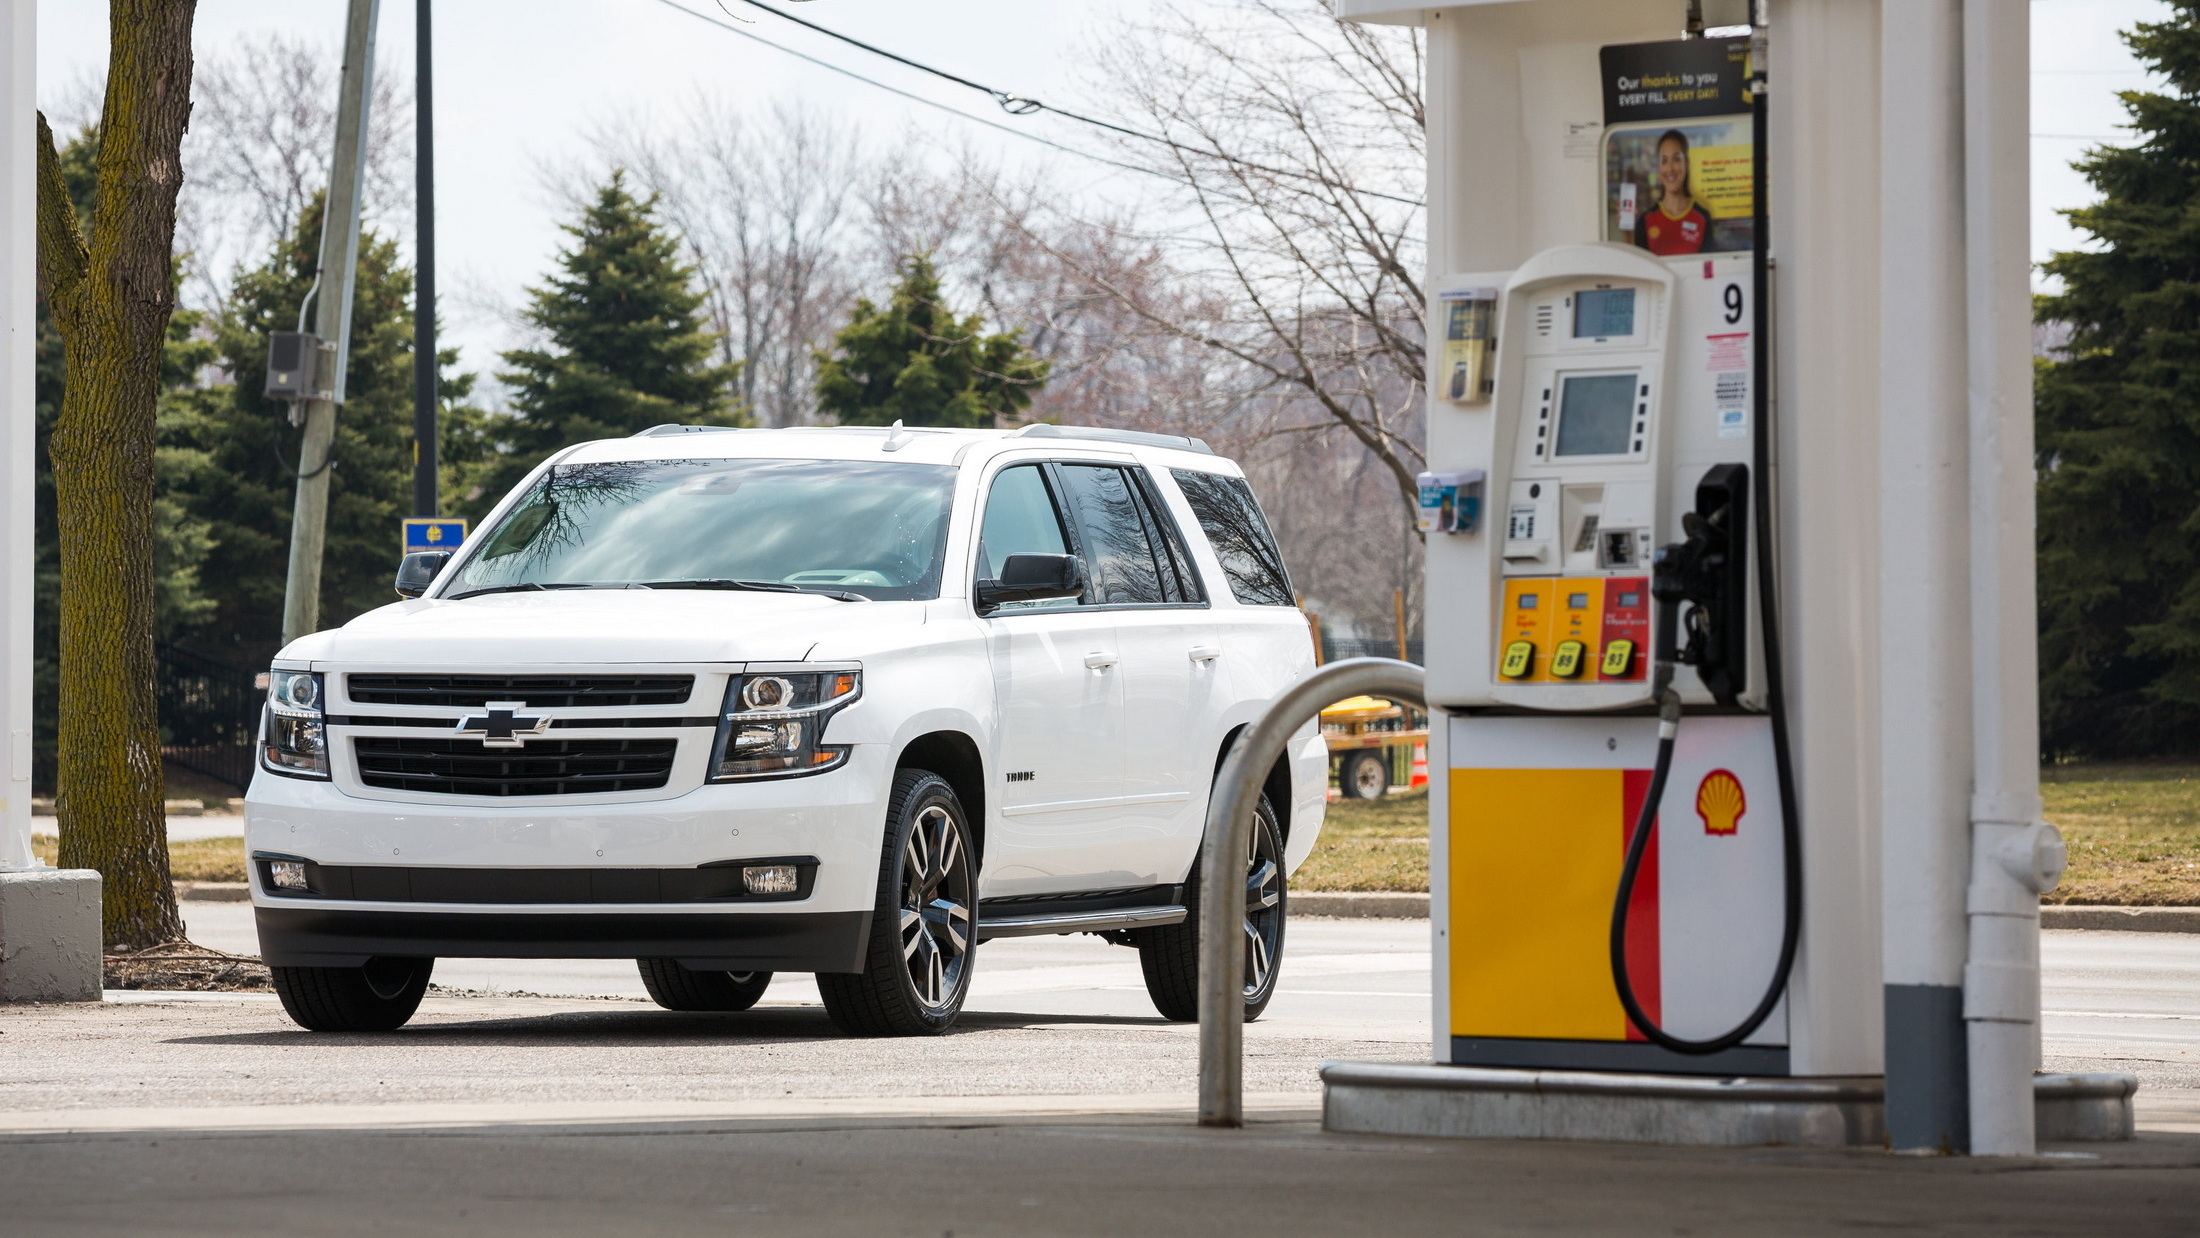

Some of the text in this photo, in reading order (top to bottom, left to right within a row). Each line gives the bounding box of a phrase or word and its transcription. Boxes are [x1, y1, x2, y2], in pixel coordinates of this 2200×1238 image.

[1617, 72, 1718, 91] Our thanks to you
[1618, 93, 1647, 107] EVERY
[1668, 90, 1695, 103] EVERY
[1724, 283, 1743, 325] 9
[1507, 655, 1523, 668] 87
[1557, 654, 1573, 667] 89
[1608, 653, 1624, 666] 93
[1006, 771, 1035, 783] TAHOE
